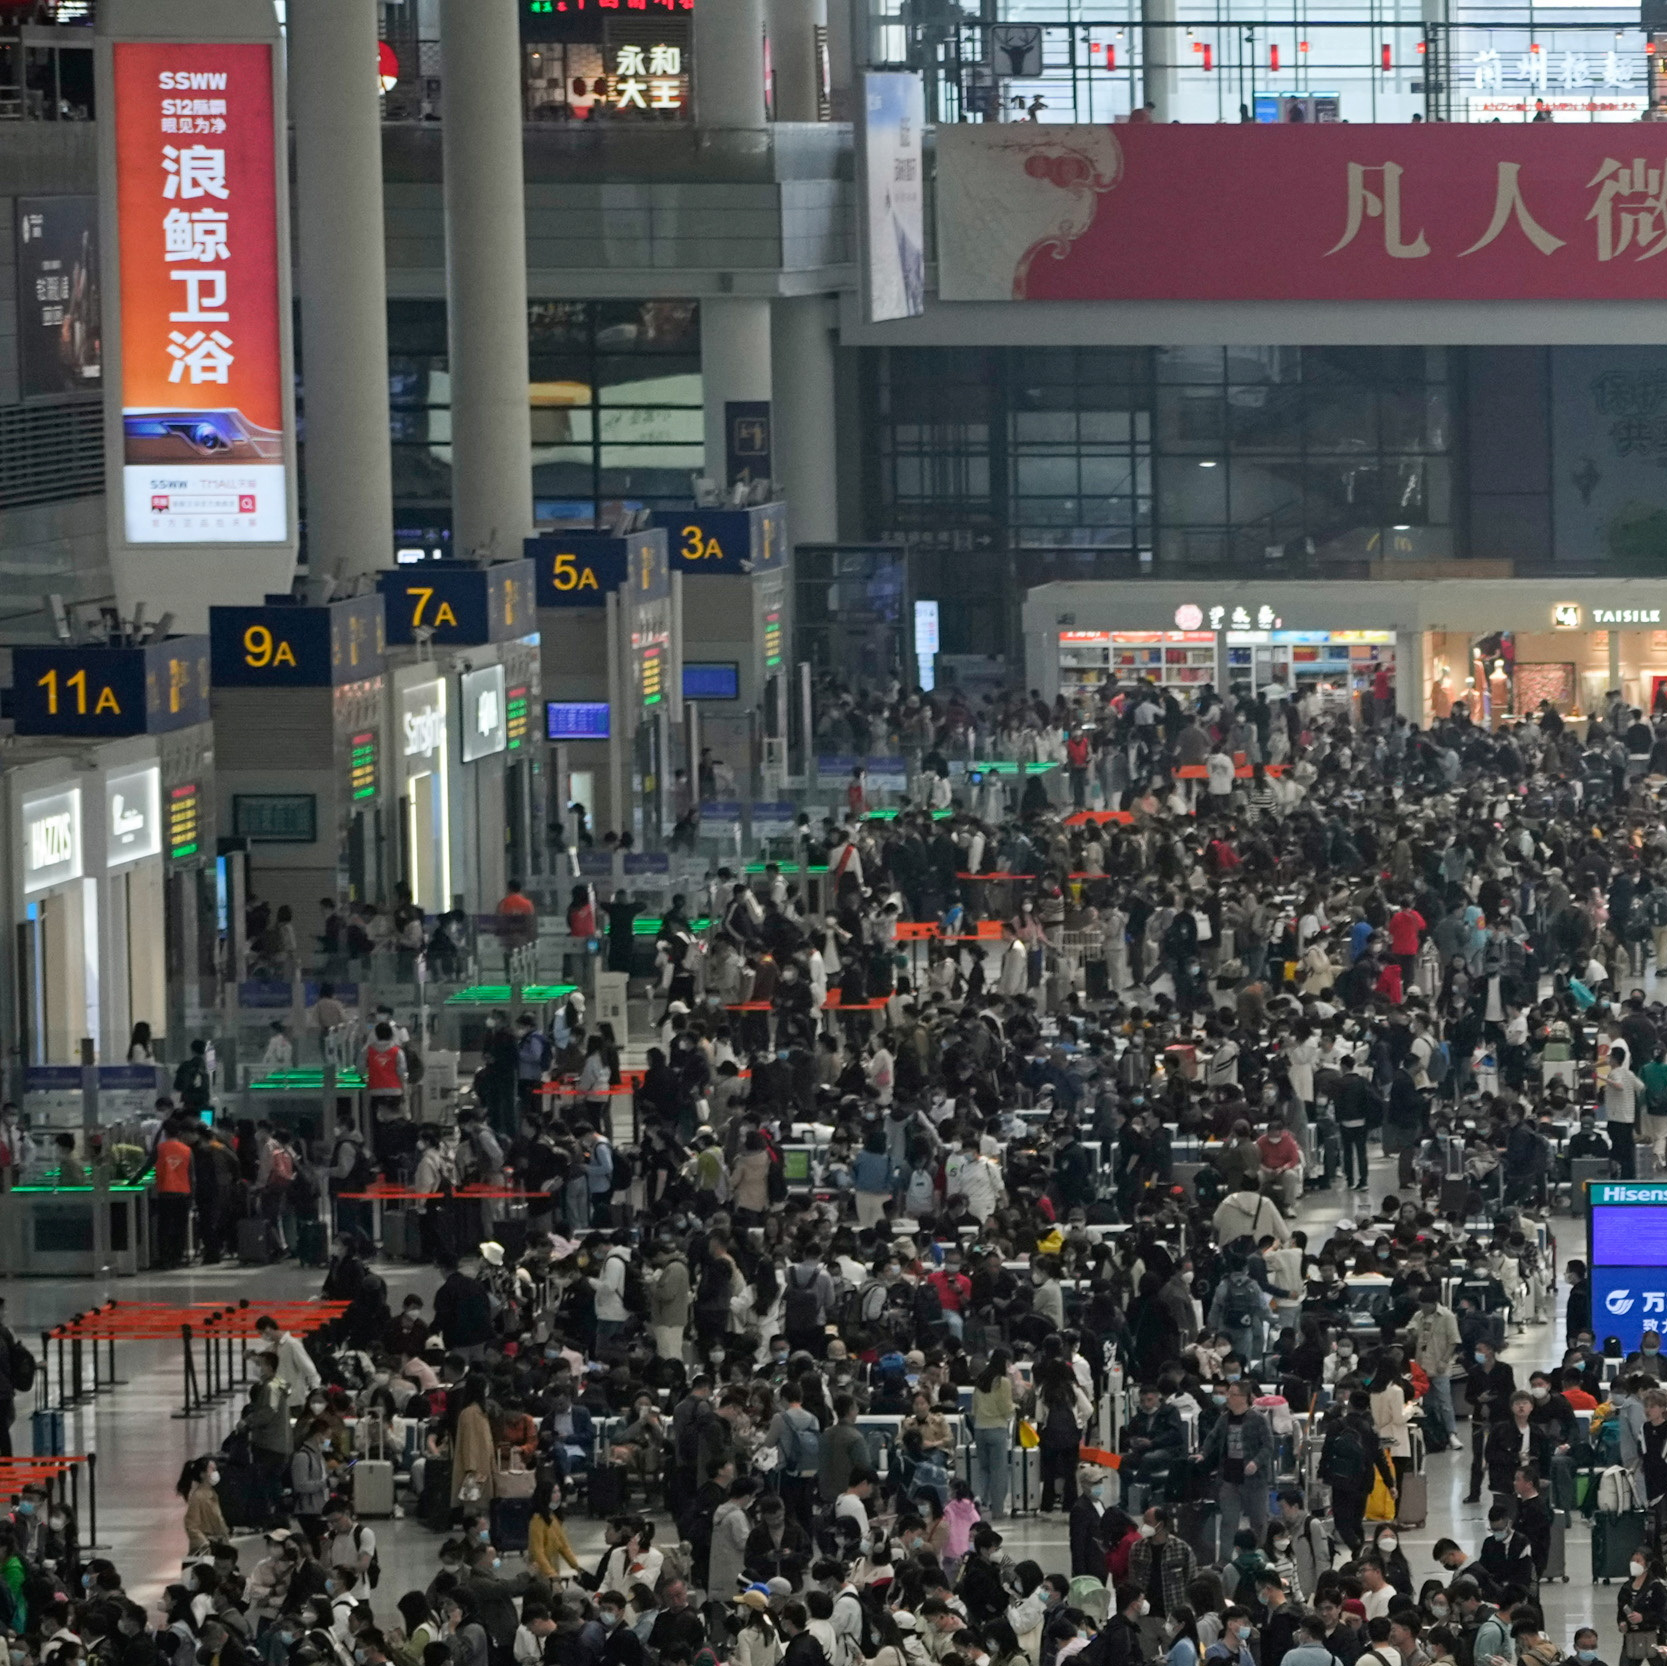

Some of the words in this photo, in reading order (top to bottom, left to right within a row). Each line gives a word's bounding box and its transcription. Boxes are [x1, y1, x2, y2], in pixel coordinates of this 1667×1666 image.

[616, 44, 681, 76] 永和
[158, 71, 228, 91] SSWW
[616, 78, 682, 109] 大王
[160, 117, 227, 134] 眼见为净
[161, 144, 235, 386] 浪鲸卫浴
[150, 479, 189, 489] SSWW
[680, 525, 724, 561] 3A
[552, 553, 599, 590] 5A
[406, 587, 458, 627] 7A
[1593, 609, 1661, 623] TAISILK
[242, 625, 296, 668] 9A
[37, 669, 122, 715] 11A
